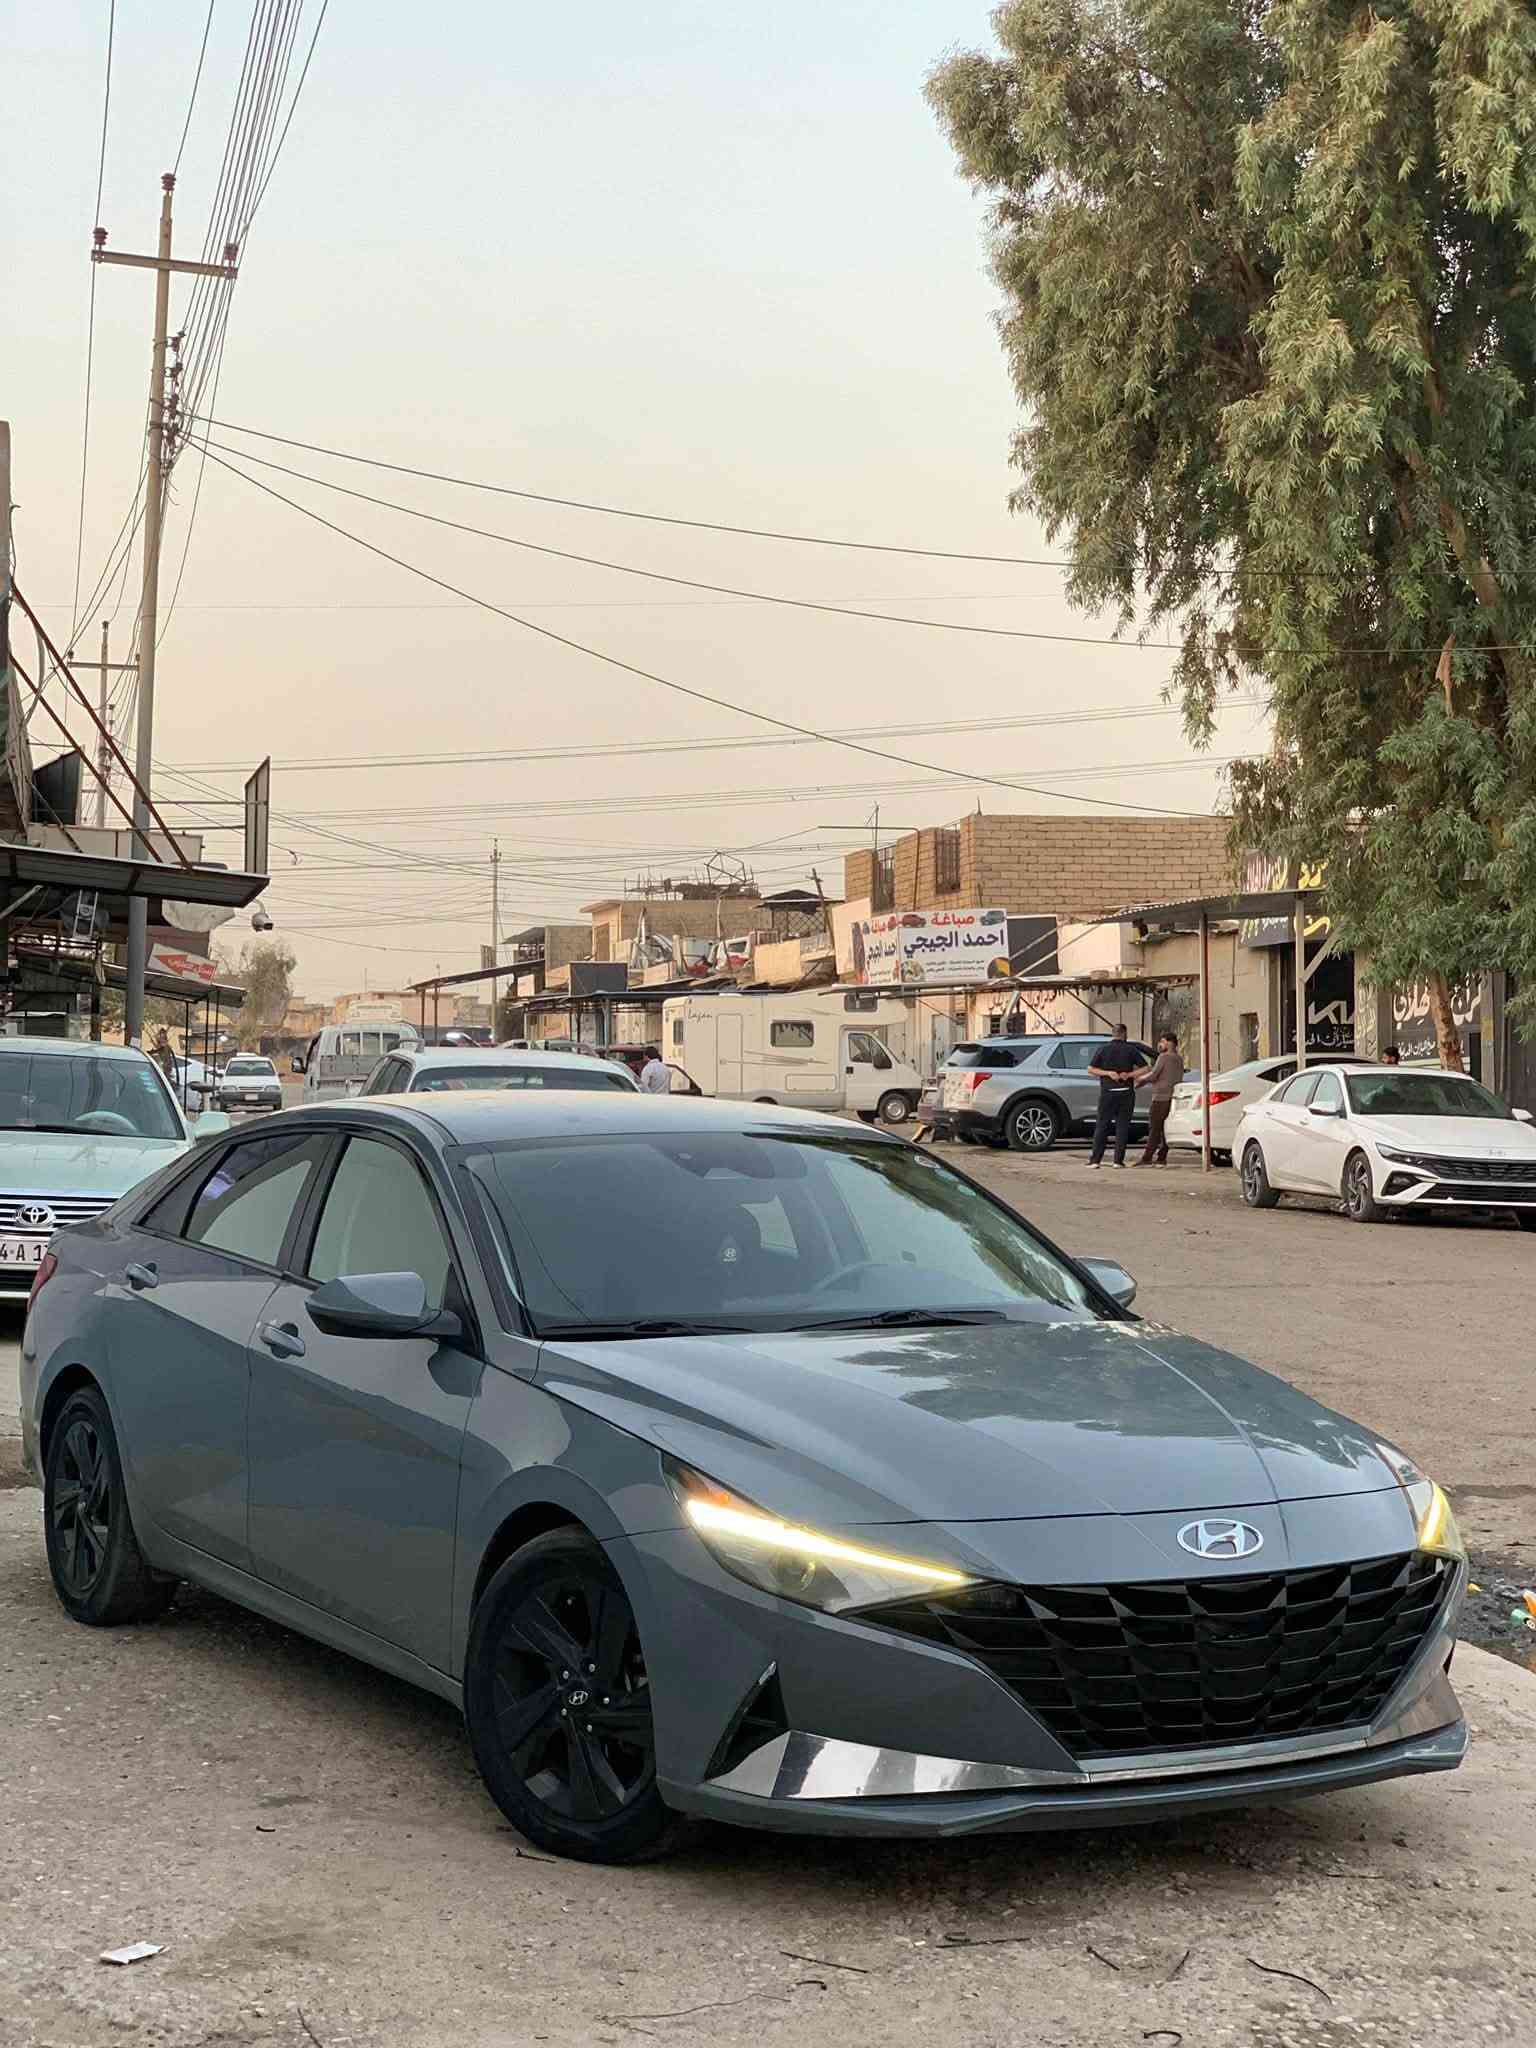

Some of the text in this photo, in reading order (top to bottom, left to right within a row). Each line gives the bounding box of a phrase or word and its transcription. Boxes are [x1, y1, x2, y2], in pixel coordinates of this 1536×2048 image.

[931, 913, 975, 928] صباغة
[904, 929, 1004, 959] احمد الجيجي
[33, 1244, 48, 1261] 1
